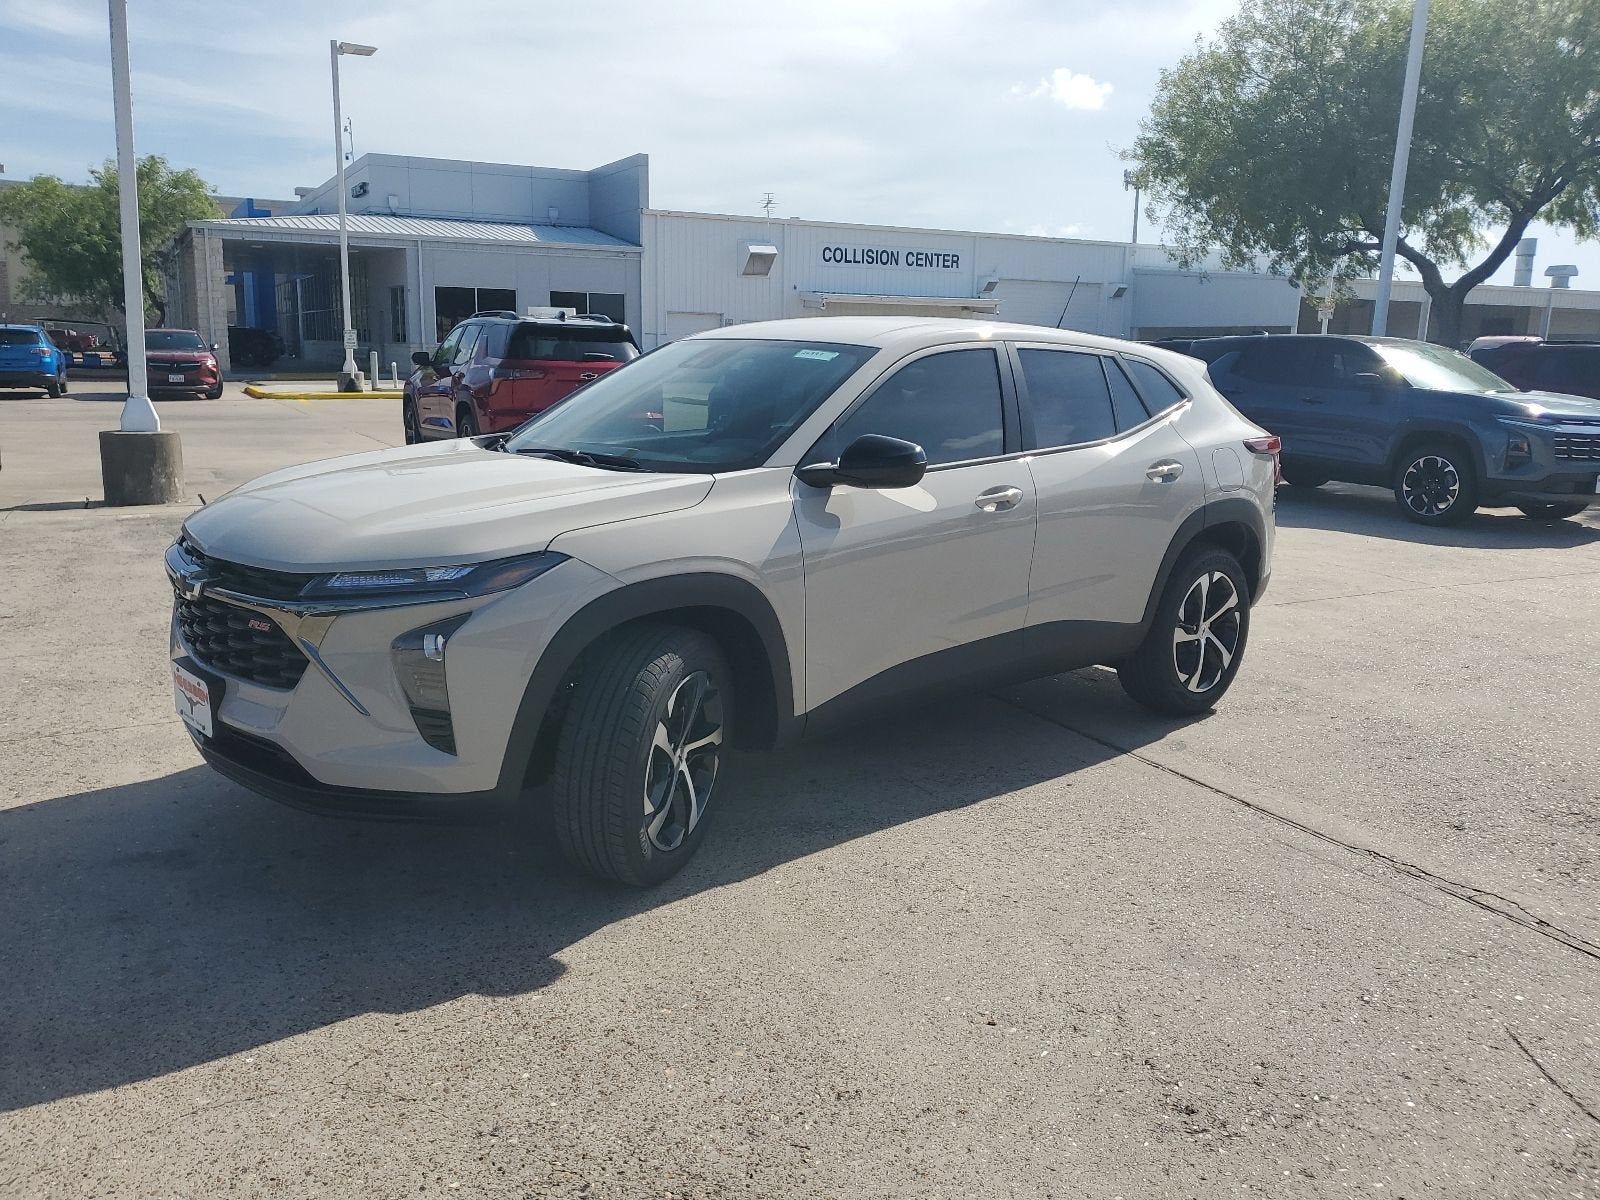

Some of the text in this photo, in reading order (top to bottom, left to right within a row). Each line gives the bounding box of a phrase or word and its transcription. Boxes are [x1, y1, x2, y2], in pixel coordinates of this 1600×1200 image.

[822, 246, 960, 269] COLLISION CENTER
[248, 619, 271, 631] RS
